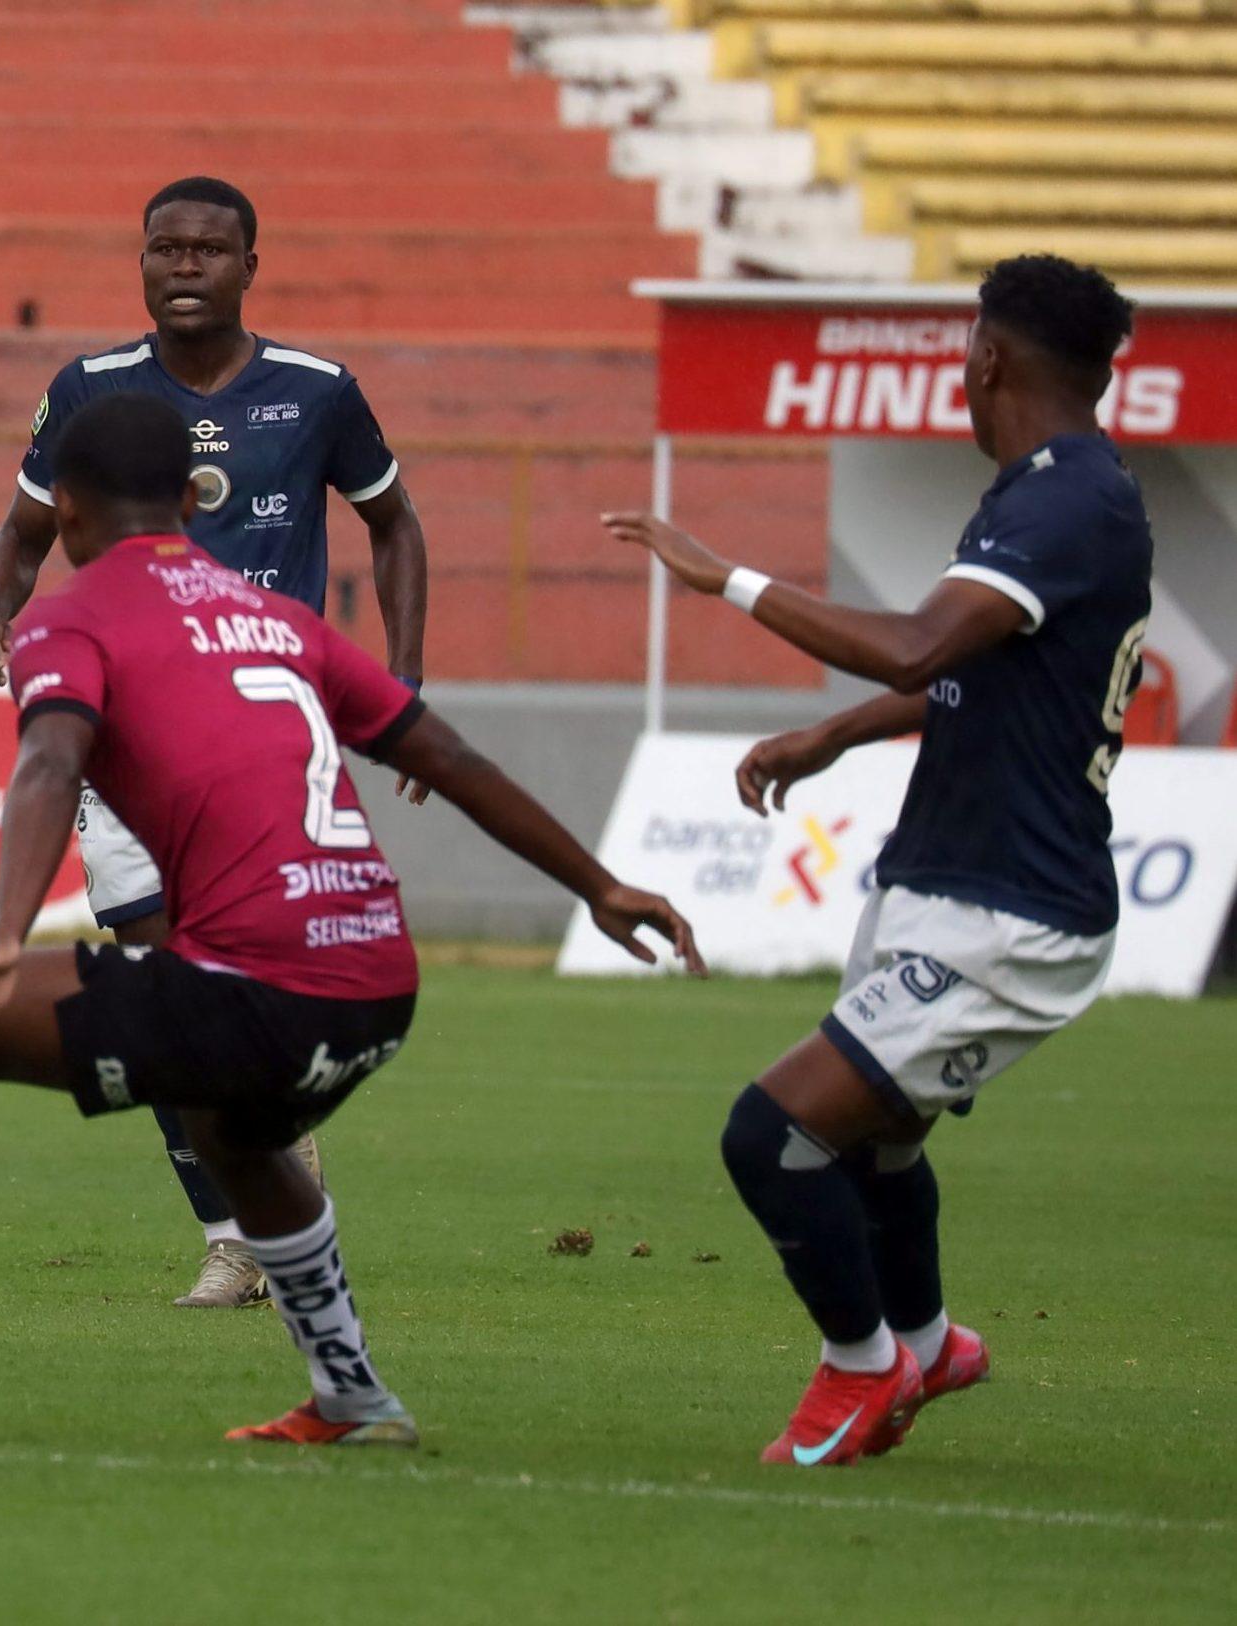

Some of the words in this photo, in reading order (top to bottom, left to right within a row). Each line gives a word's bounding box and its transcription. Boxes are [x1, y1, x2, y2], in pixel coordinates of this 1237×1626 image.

[263, 402, 300, 412] HOSPITAL
[763, 361, 1185, 434] HINCS
[263, 411, 281, 422] DEL
[282, 409, 300, 420] RIO
[192, 440, 230, 453] STRO
[251, 492, 289, 517] UC
[182, 612, 304, 657] J.ARCOS
[640, 815, 775, 855] banco
[693, 858, 762, 896] del
